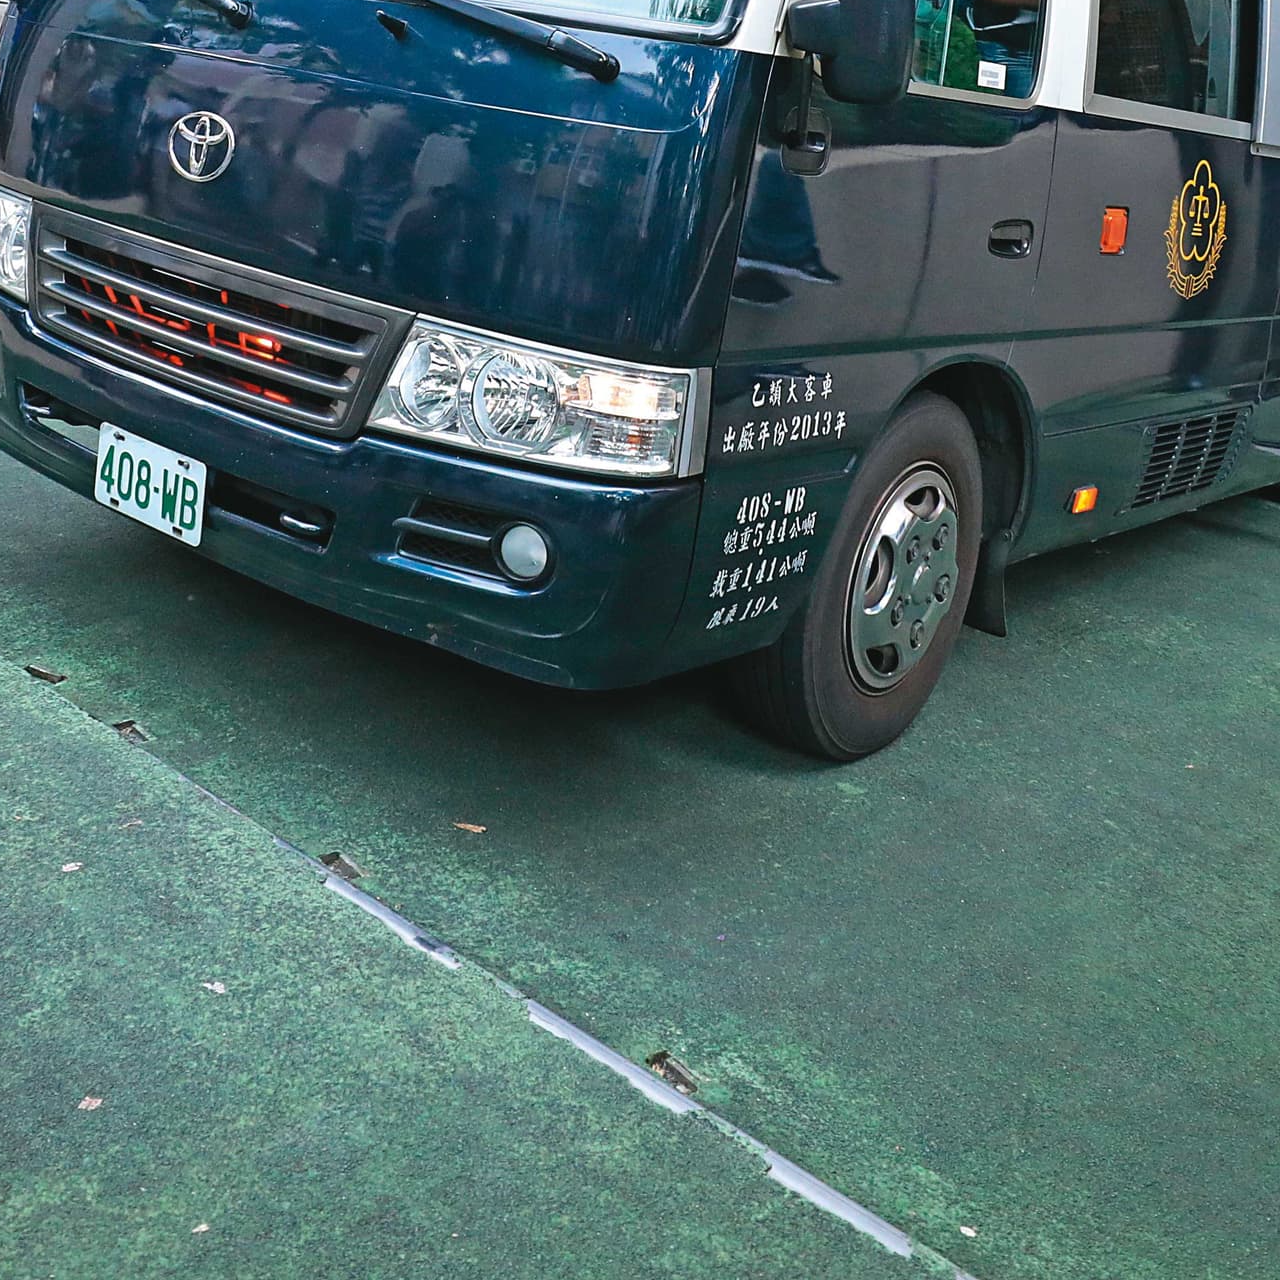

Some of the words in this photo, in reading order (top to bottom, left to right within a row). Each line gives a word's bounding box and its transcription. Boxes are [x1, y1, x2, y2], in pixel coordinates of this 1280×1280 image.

[752, 372, 833, 407] 乙類大客車
[723, 411, 846, 453] 出廠年份2013年
[100, 445, 198, 530] 408-WB
[737, 487, 806, 524] 408-WB
